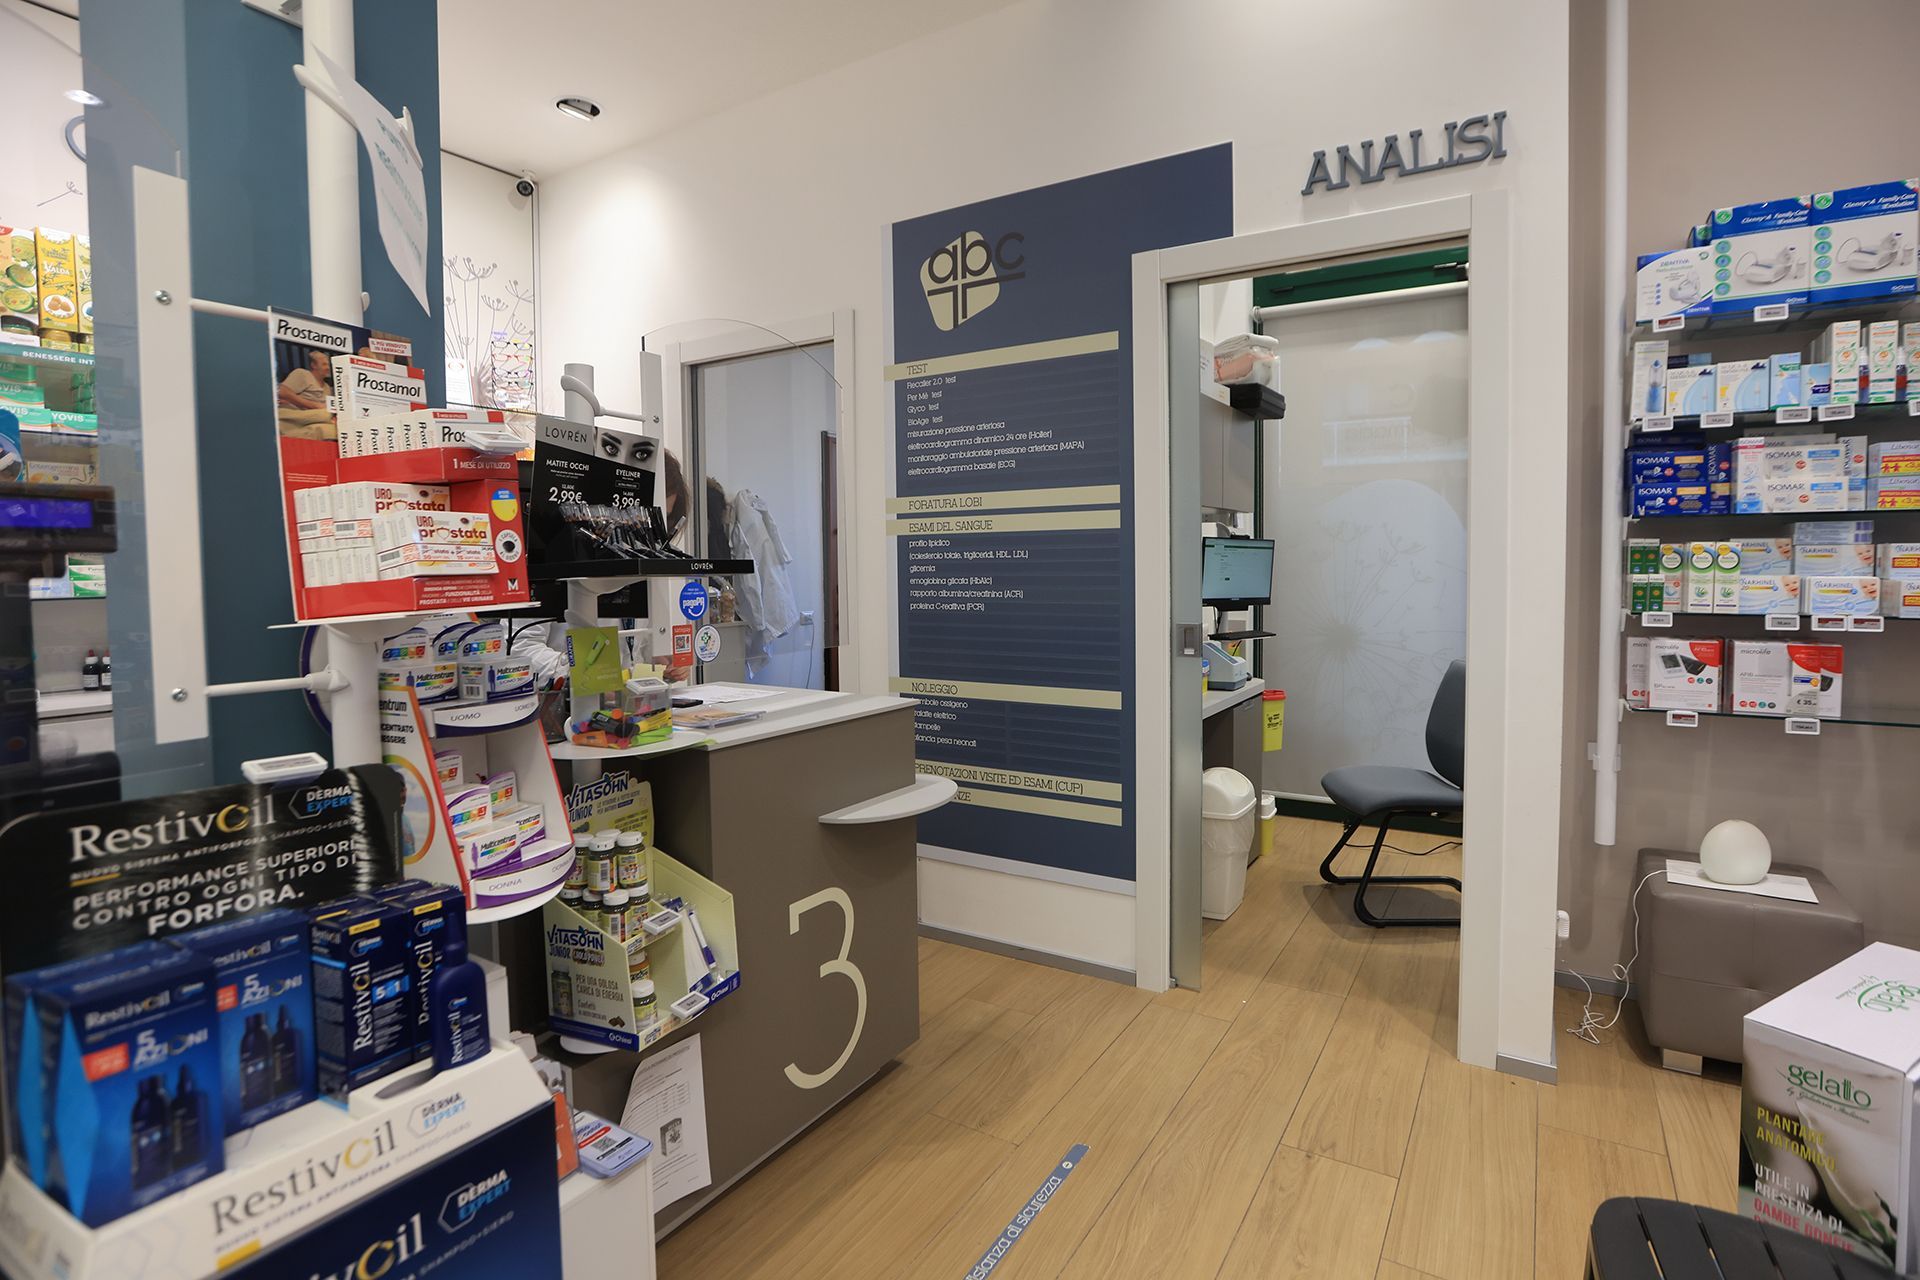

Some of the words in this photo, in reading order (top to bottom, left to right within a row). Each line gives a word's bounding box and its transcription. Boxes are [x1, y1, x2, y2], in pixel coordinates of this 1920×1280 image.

[1301, 111, 1507, 195] ANALISI
[927, 231, 1025, 284] abc
[43, 261, 71, 276] VALDA
[277, 319, 347, 348] Prostamol
[22, 350, 76, 363] BENESSERE
[907, 363, 928, 375] TEST
[357, 373, 421, 398] Prostamol
[933, 377, 943, 386] 2.0
[945, 376, 957, 384] test
[335, 366, 344, 412] Prostamol
[931, 391, 942, 399] test
[907, 405, 926, 414] Glyco
[928, 403, 939, 411] test
[51, 412, 84, 423] YOVIS
[908, 417, 930, 426] BioAge
[545, 426, 587, 443] LOVRÉN
[907, 427, 944, 438] misurazione
[945, 424, 975, 435] pressione
[976, 422, 1005, 431] arteriosa
[907, 439, 972, 451] elettrocardiogramma
[973, 435, 1005, 444] dinamico
[1006, 433, 1014, 441] 24
[1015, 432, 1027, 440] ore
[1028, 429, 1052, 440] (Holter)
[907, 452, 948, 463] monitoraggio
[949, 448, 993, 459] ambulatoriale
[994, 446, 1026, 456] pressione
[1028, 443, 1058, 453] arteriosa
[1059, 440, 1085, 451] (MAPA)
[1765, 450, 1803, 459] ISOMAR
[452, 458, 458, 469] 1
[460, 461, 477, 469] MESE
[477, 461, 484, 469] DI
[485, 461, 511, 469] UTILIZZO
[546, 459, 568, 468] MATITE
[569, 462, 589, 471] OCCHI
[1637, 456, 1670, 465] ISOMAR
[615, 468, 641, 478] EYELINER
[907, 464, 972, 476] elettrocardiogramma
[973, 461, 996, 470] basale
[374, 487, 392, 500] URO
[1638, 487, 1672, 495] ISOMAR
[1768, 483, 1805, 491] ISOMAR
[548, 486, 582, 504] 2,99€
[375, 499, 446, 513] prostata
[908, 497, 958, 510] FORATURA
[960, 496, 982, 508] LOBI
[416, 515, 434, 527] URO
[909, 522, 934, 533] ESAMI
[936, 521, 953, 532] DEL
[955, 520, 993, 531] SANGUE
[419, 527, 487, 541] prostata
[909, 540, 927, 548] profilo
[928, 539, 950, 548] lipidico
[690, 562, 714, 570] LOVRÉN
[910, 565, 936, 573] glicemia
[910, 577, 946, 585] emoglobina
[910, 590, 937, 598] rapporto
[938, 590, 1003, 598] albumina/creatinina
[1004, 590, 1024, 598] (ACR)
[910, 602, 935, 611] proteina
[967, 603, 984, 611] (PCR)
[497, 664, 530, 675] Multicentrum
[416, 672, 455, 682] Multicentrum
[912, 682, 958, 695] NOLEGGIO
[379, 698, 407, 711] entrum
[940, 700, 968, 709] ossigeno
[450, 713, 481, 722] UOMO
[914, 722, 941, 731] tampelle
[380, 735, 407, 744] ESSERE
[953, 738, 977, 747] neonati
[980, 770, 1007, 784] VISITE
[1009, 774, 1022, 786] ED
[1024, 776, 1053, 790] ESAMI
[1055, 780, 1084, 795] (CUP)
[306, 785, 351, 802] DERMA
[953, 790, 971, 802] NZE
[481, 834, 517, 852] Multicentrum
[124, 853, 180, 871] SISTEMA
[185, 836, 267, 859] ANTIFORFORA
[72, 891, 191, 931] CONTRO
[203, 875, 264, 900] OGNI
[275, 861, 327, 882] TIPO
[336, 851, 357, 869] DI
[73, 861, 249, 913] PERFORMANCE
[488, 878, 522, 891] DONNA
[147, 884, 304, 936] FORFORA.
[244, 973, 259, 988] 5
[783, 887, 868, 1089] 3
[137, 1029, 155, 1048] 5
[422, 1092, 461, 1118] DERMA
[423, 1100, 468, 1130] EXPERT
[1757, 1106, 1825, 1146] PLANTARE
[1755, 1163, 1792, 1190] UTILE
[1796, 1182, 1810, 1200] IN
[457, 1169, 509, 1208] DERMA
[458, 1177, 513, 1222] EXPERT
[1007, 1223, 1022, 1238] di
[1016, 1175, 1063, 1226] sicurezza
[1754, 1180, 1824, 1224] PRESENZA
[1828, 1215, 1843, 1233] DI
[1754, 1198, 1800, 1232] GAMBE
